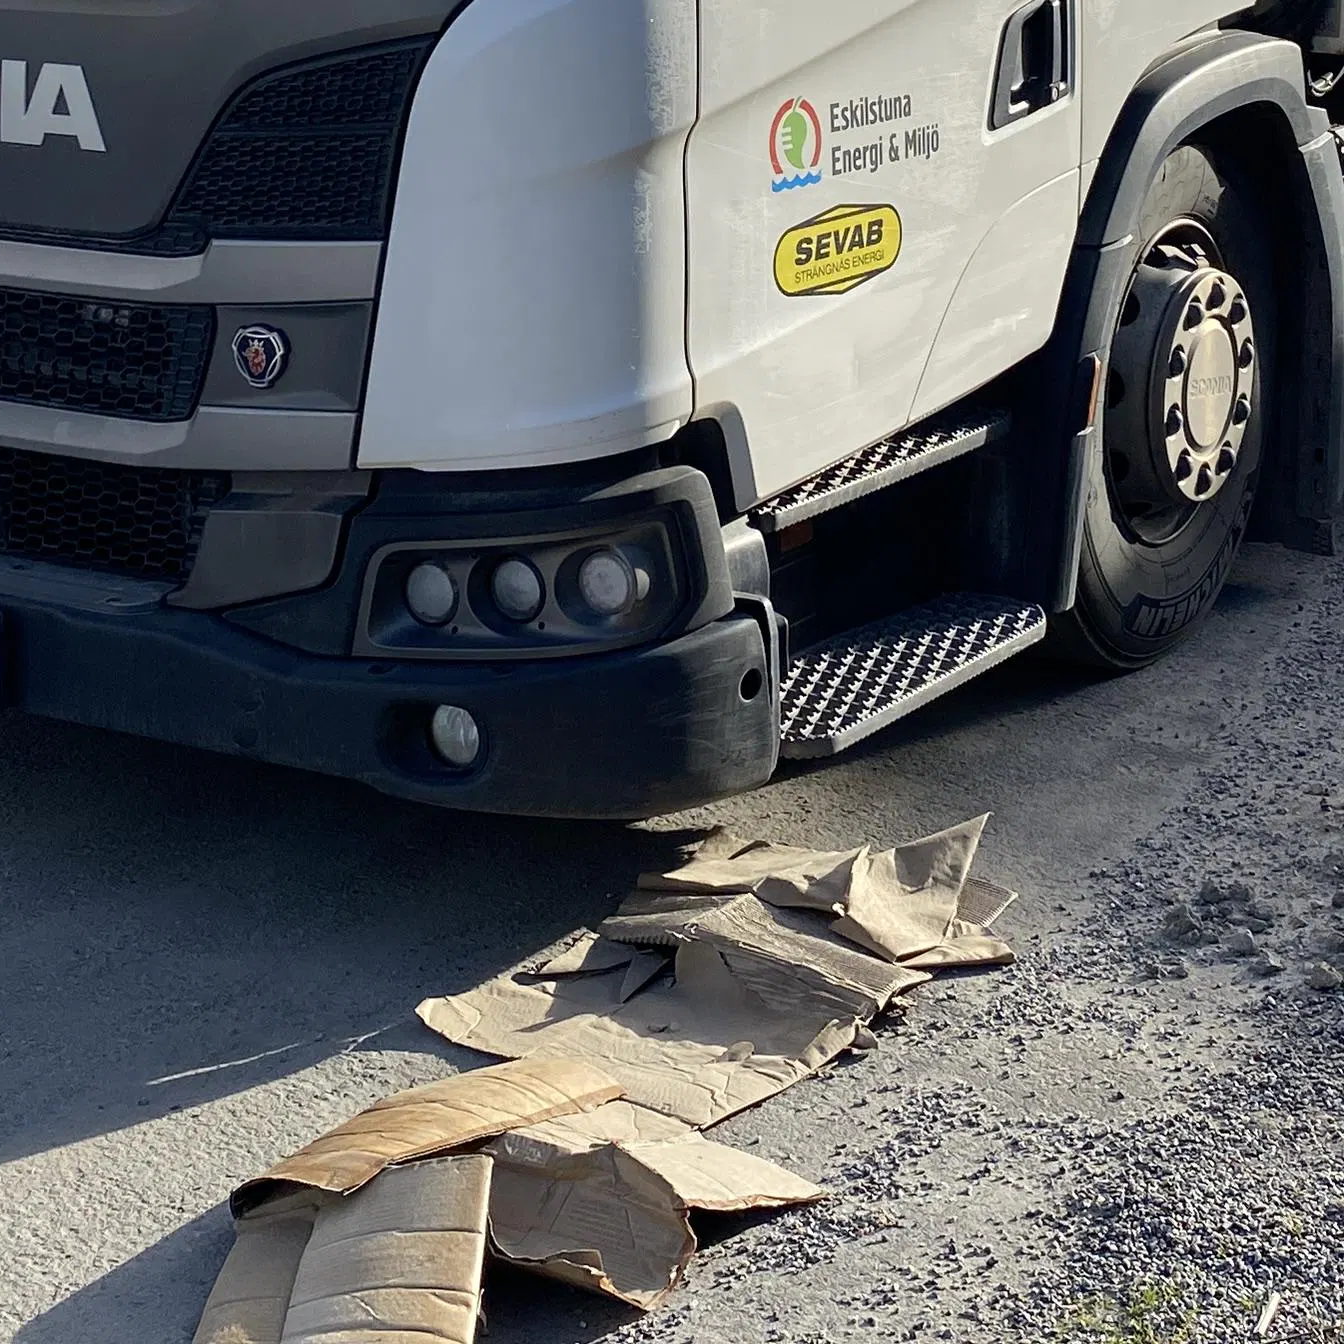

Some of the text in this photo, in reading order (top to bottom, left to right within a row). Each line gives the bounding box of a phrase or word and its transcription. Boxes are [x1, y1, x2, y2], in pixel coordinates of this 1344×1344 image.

[830, 94, 912, 133] Eskilstuna
[831, 124, 940, 176] Energi & Miljö
[794, 219, 884, 266] SEVAB
[852, 249, 885, 268] ENERGI
